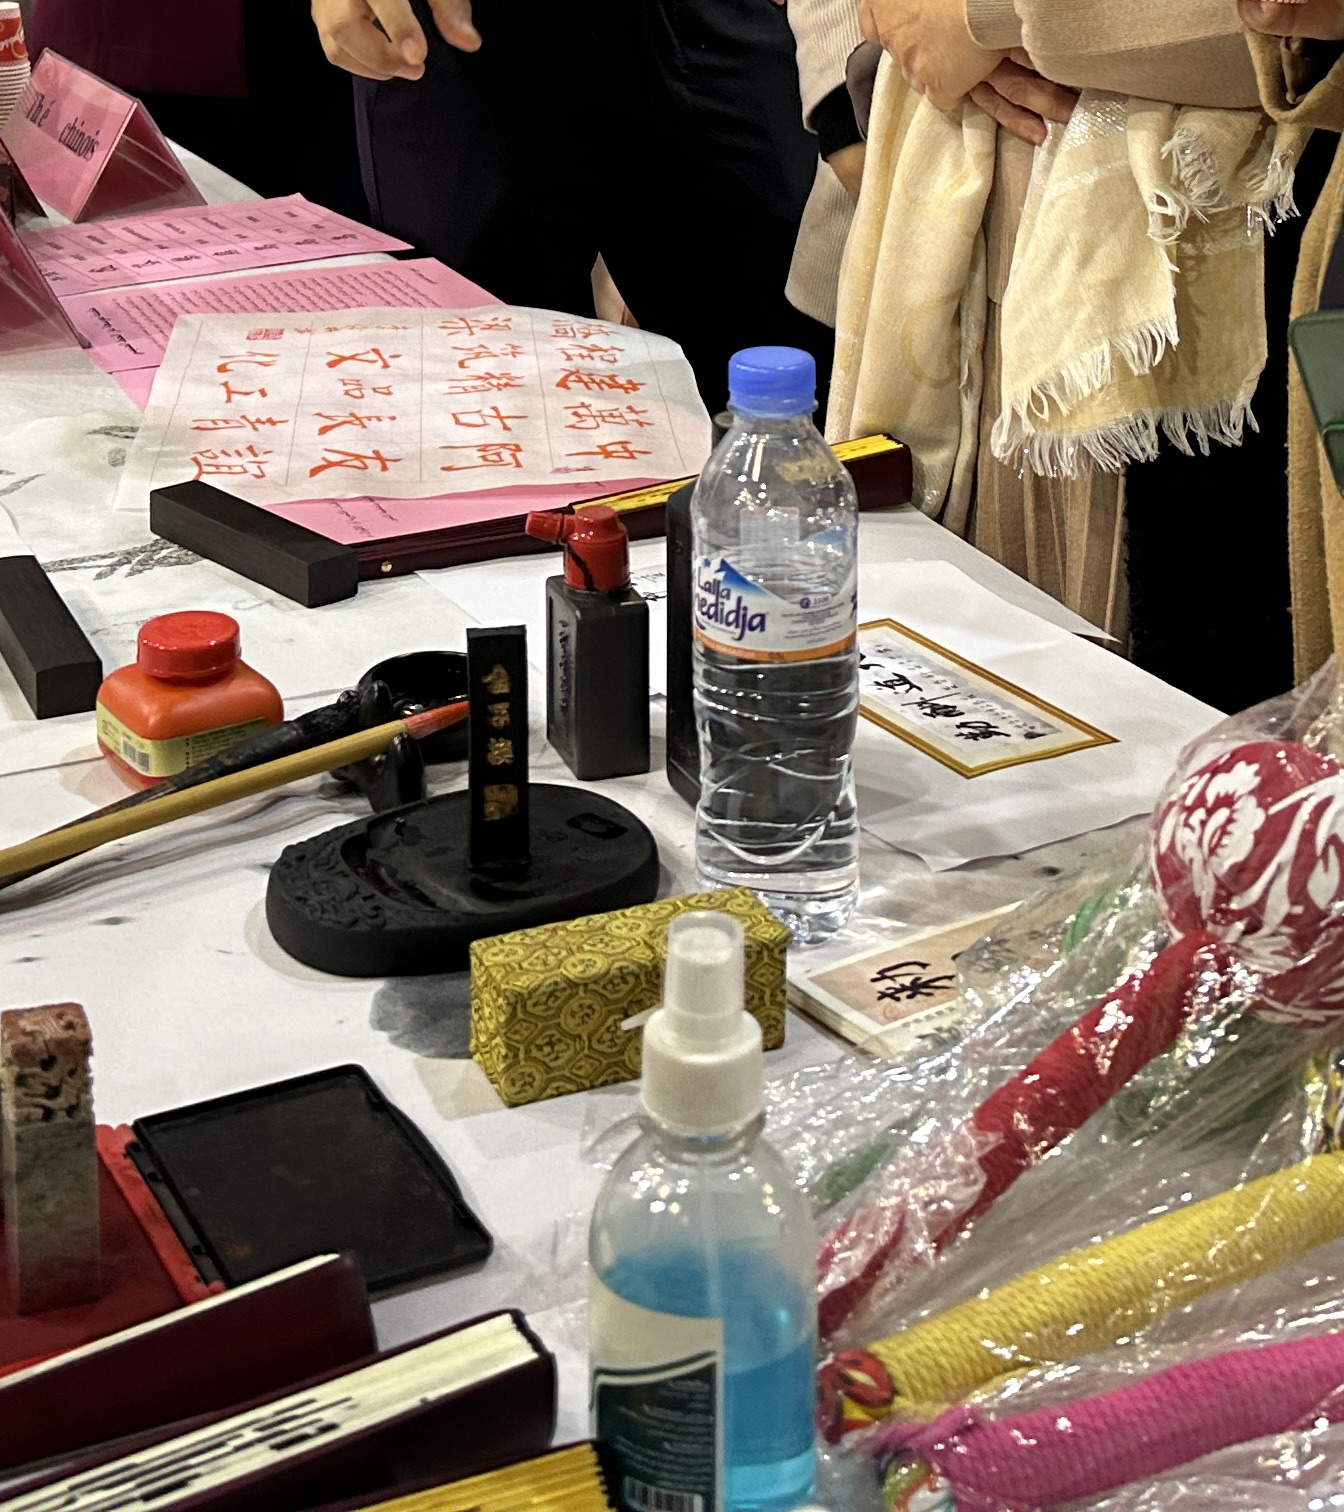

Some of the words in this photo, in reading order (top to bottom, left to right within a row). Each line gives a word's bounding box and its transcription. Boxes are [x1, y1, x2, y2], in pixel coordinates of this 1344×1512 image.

[58, 116, 101, 162] chinois
[698, 566, 731, 600] Lalla
[696, 593, 768, 641] hedidja
